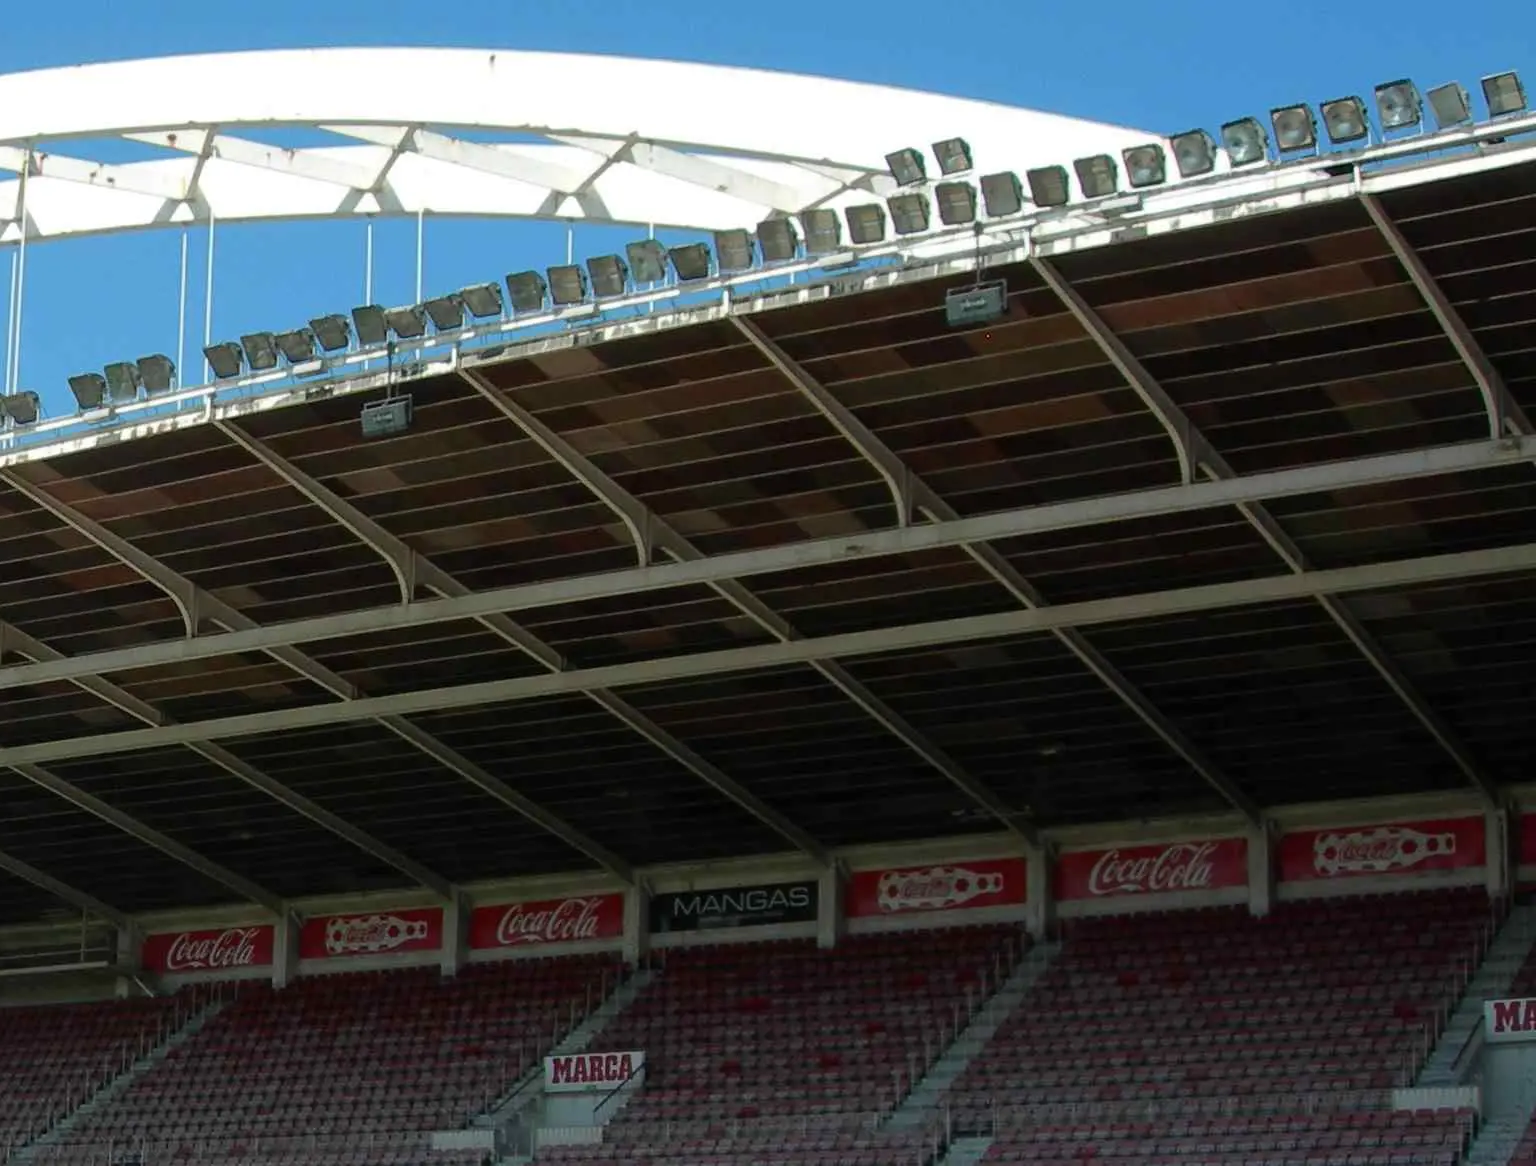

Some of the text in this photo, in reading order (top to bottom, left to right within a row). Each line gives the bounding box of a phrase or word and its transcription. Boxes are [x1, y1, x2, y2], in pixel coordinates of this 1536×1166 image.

[1088, 841, 1221, 895] Coca-Cola
[496, 896, 605, 944] Coca-Cola
[672, 886, 811, 917] MANGAS
[552, 1054, 632, 1084] MARCA
